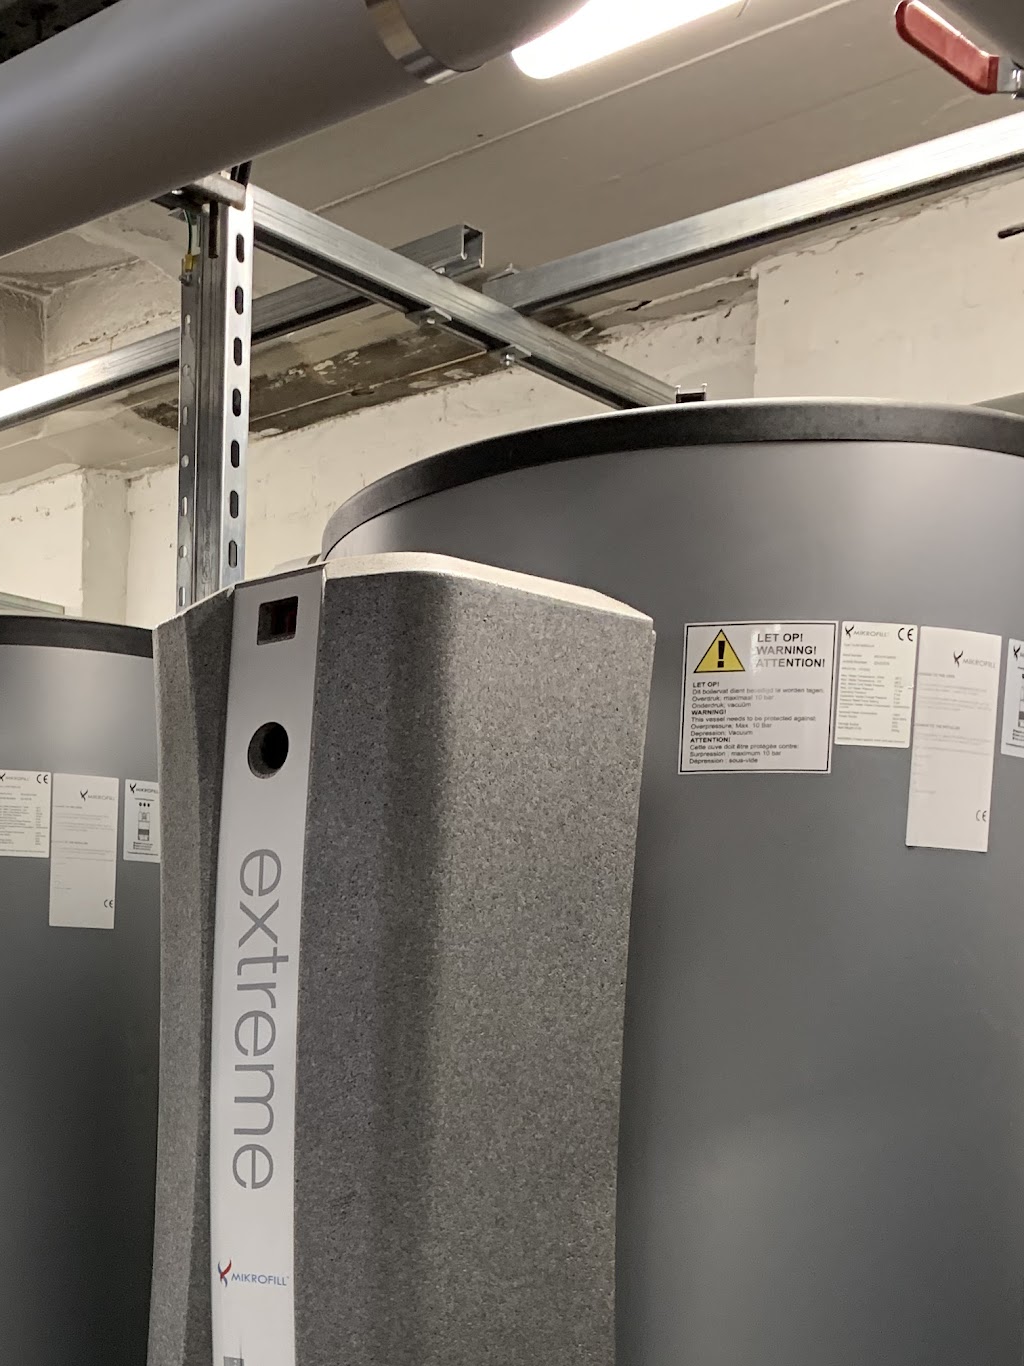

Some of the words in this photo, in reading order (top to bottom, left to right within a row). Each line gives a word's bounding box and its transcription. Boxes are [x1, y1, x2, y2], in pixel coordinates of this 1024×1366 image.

[757, 633, 779, 642] LET
[783, 633, 803, 642] OP!
[756, 646, 816, 655] WARNING!
[756, 658, 825, 668] ATTENTION!
[232, 848, 289, 1190] extreme
[231, 1272, 287, 1287] MIKROFILL
